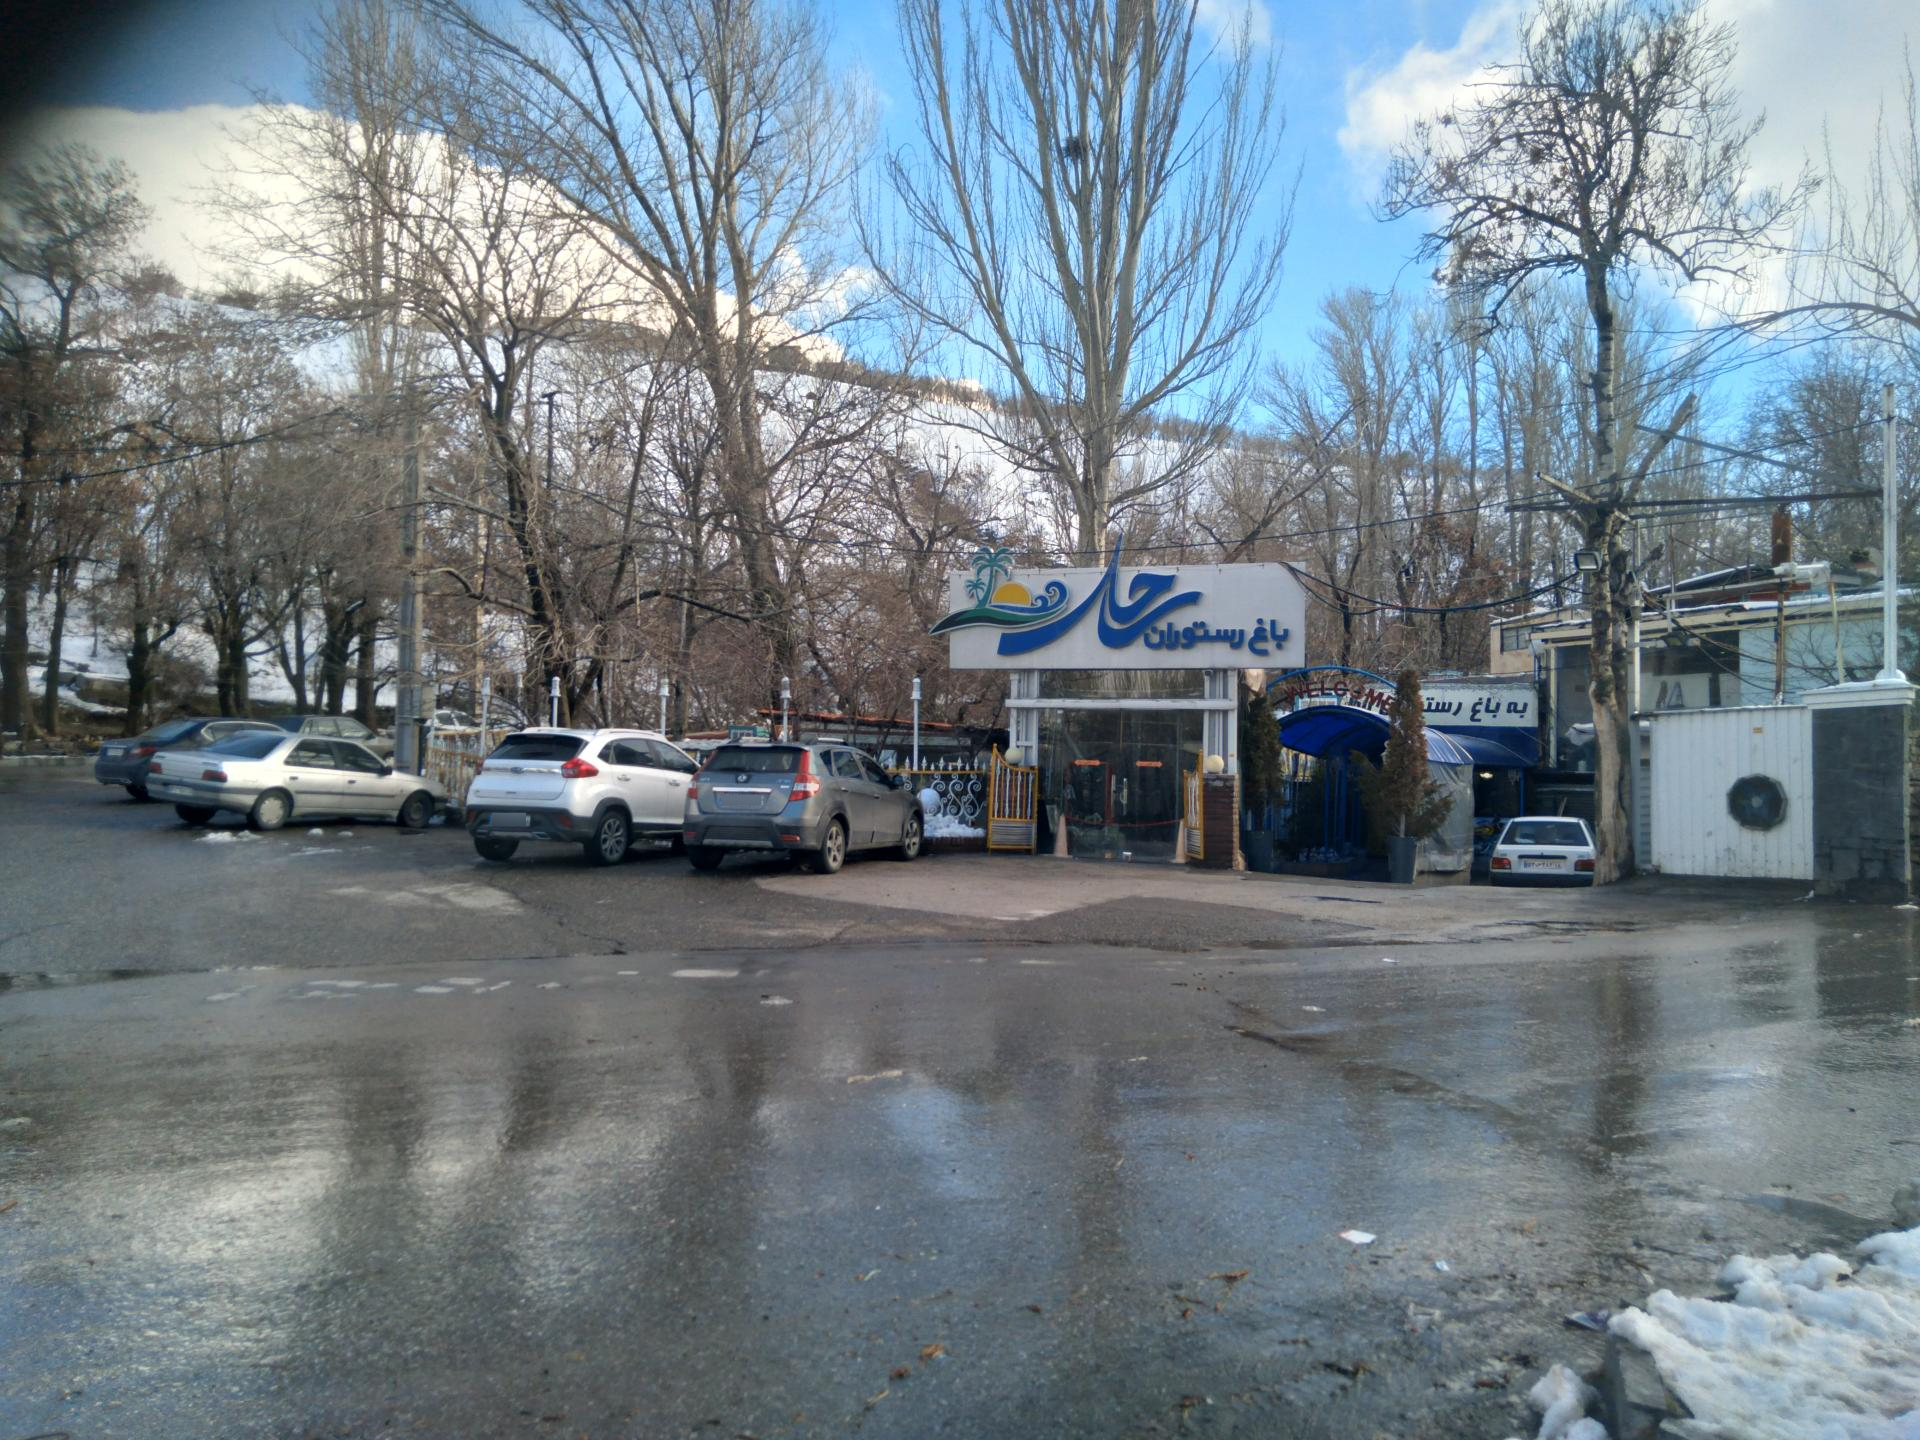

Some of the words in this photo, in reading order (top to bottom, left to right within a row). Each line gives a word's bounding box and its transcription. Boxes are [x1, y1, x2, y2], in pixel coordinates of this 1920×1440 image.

[1143, 620, 1247, 650] رستوران
[1247, 617, 1289, 656] باغ
[1286, 680, 1396, 713] WELCOME
[1469, 697, 1501, 723] باغ
[1506, 701, 1528, 719] به
